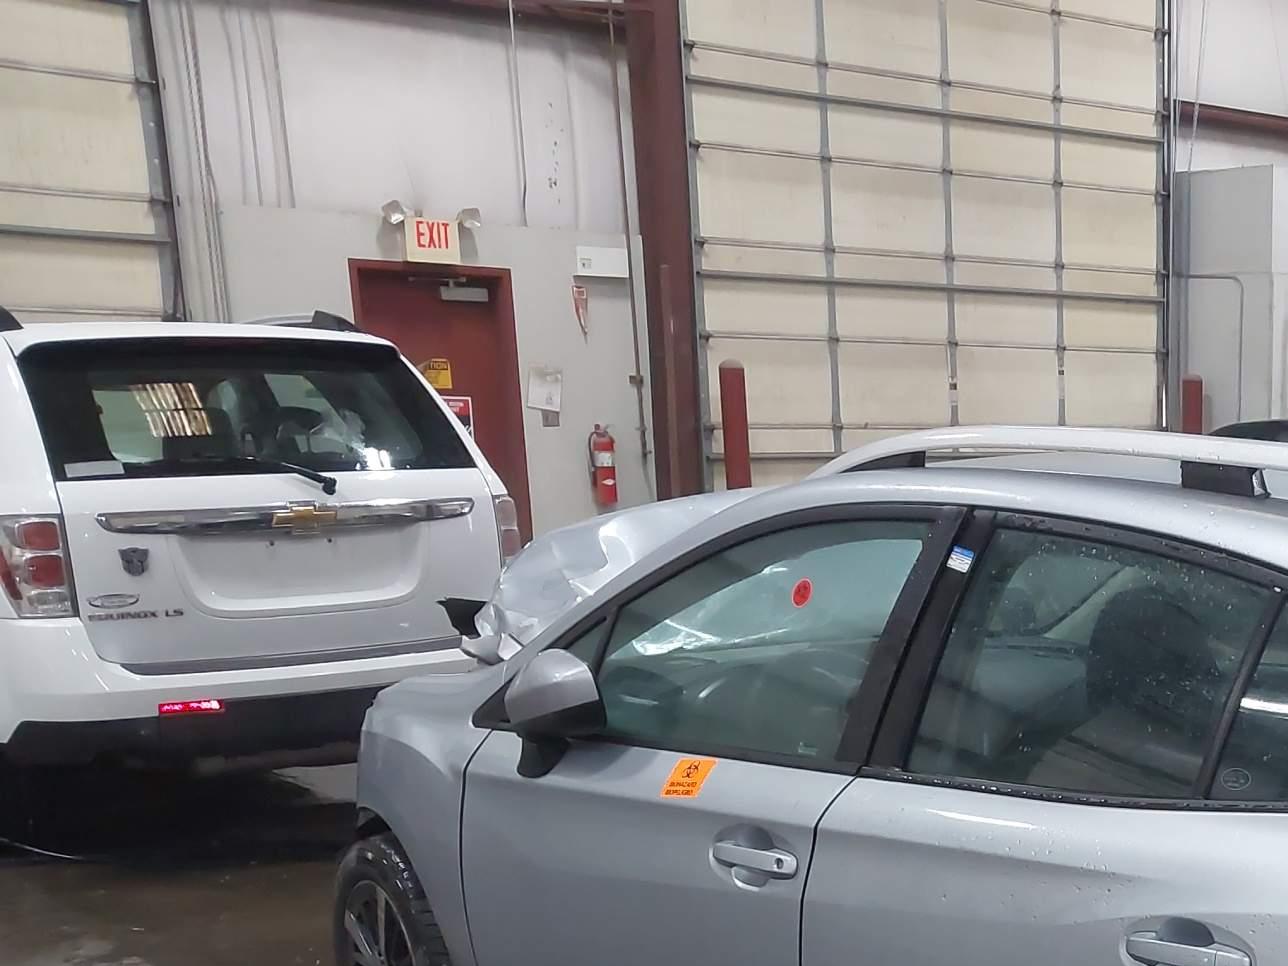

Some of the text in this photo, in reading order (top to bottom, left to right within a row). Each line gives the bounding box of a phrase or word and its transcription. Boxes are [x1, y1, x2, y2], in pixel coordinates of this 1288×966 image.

[415, 220, 450, 249] EXIT
[88, 608, 184, 622] EQUINOX LS
